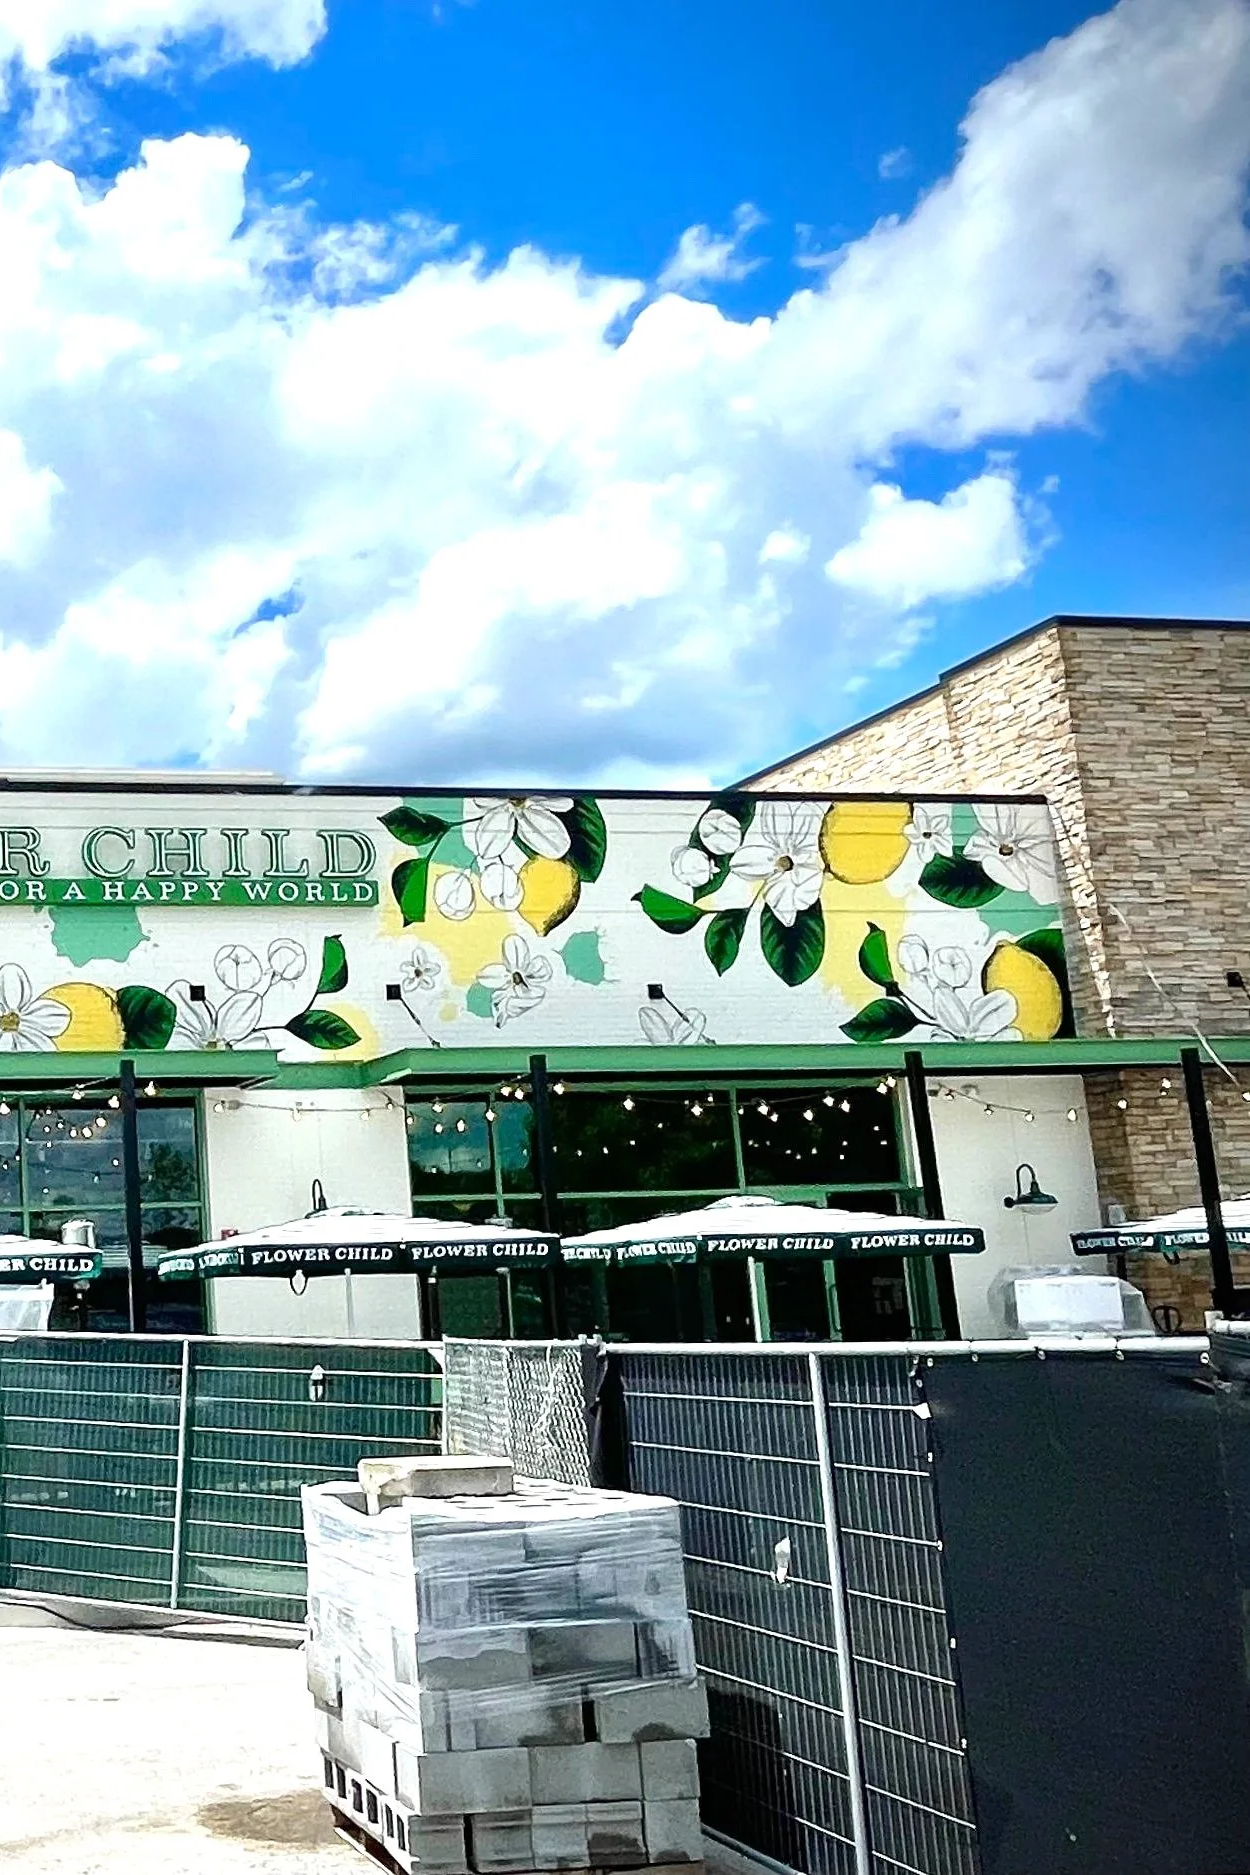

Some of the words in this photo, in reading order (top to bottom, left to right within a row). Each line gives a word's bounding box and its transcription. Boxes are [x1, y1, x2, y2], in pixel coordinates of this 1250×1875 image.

[82, 825, 376, 878] CHILD
[63, 881, 86, 901] A
[102, 881, 226, 901] HAPPY
[242, 881, 374, 902] WORLD
[707, 1237, 779, 1252] FLOWER
[782, 1237, 834, 1250] CHILD
[850, 1233, 921, 1250] FLOWER
[924, 1233, 975, 1247] CHILD
[251, 1247, 331, 1266] FLOWER
[334, 1247, 394, 1261] CHILD
[411, 1244, 492, 1261] FLOWER
[492, 1243, 549, 1257] CHILD
[29, 1257, 94, 1273] CHILD
